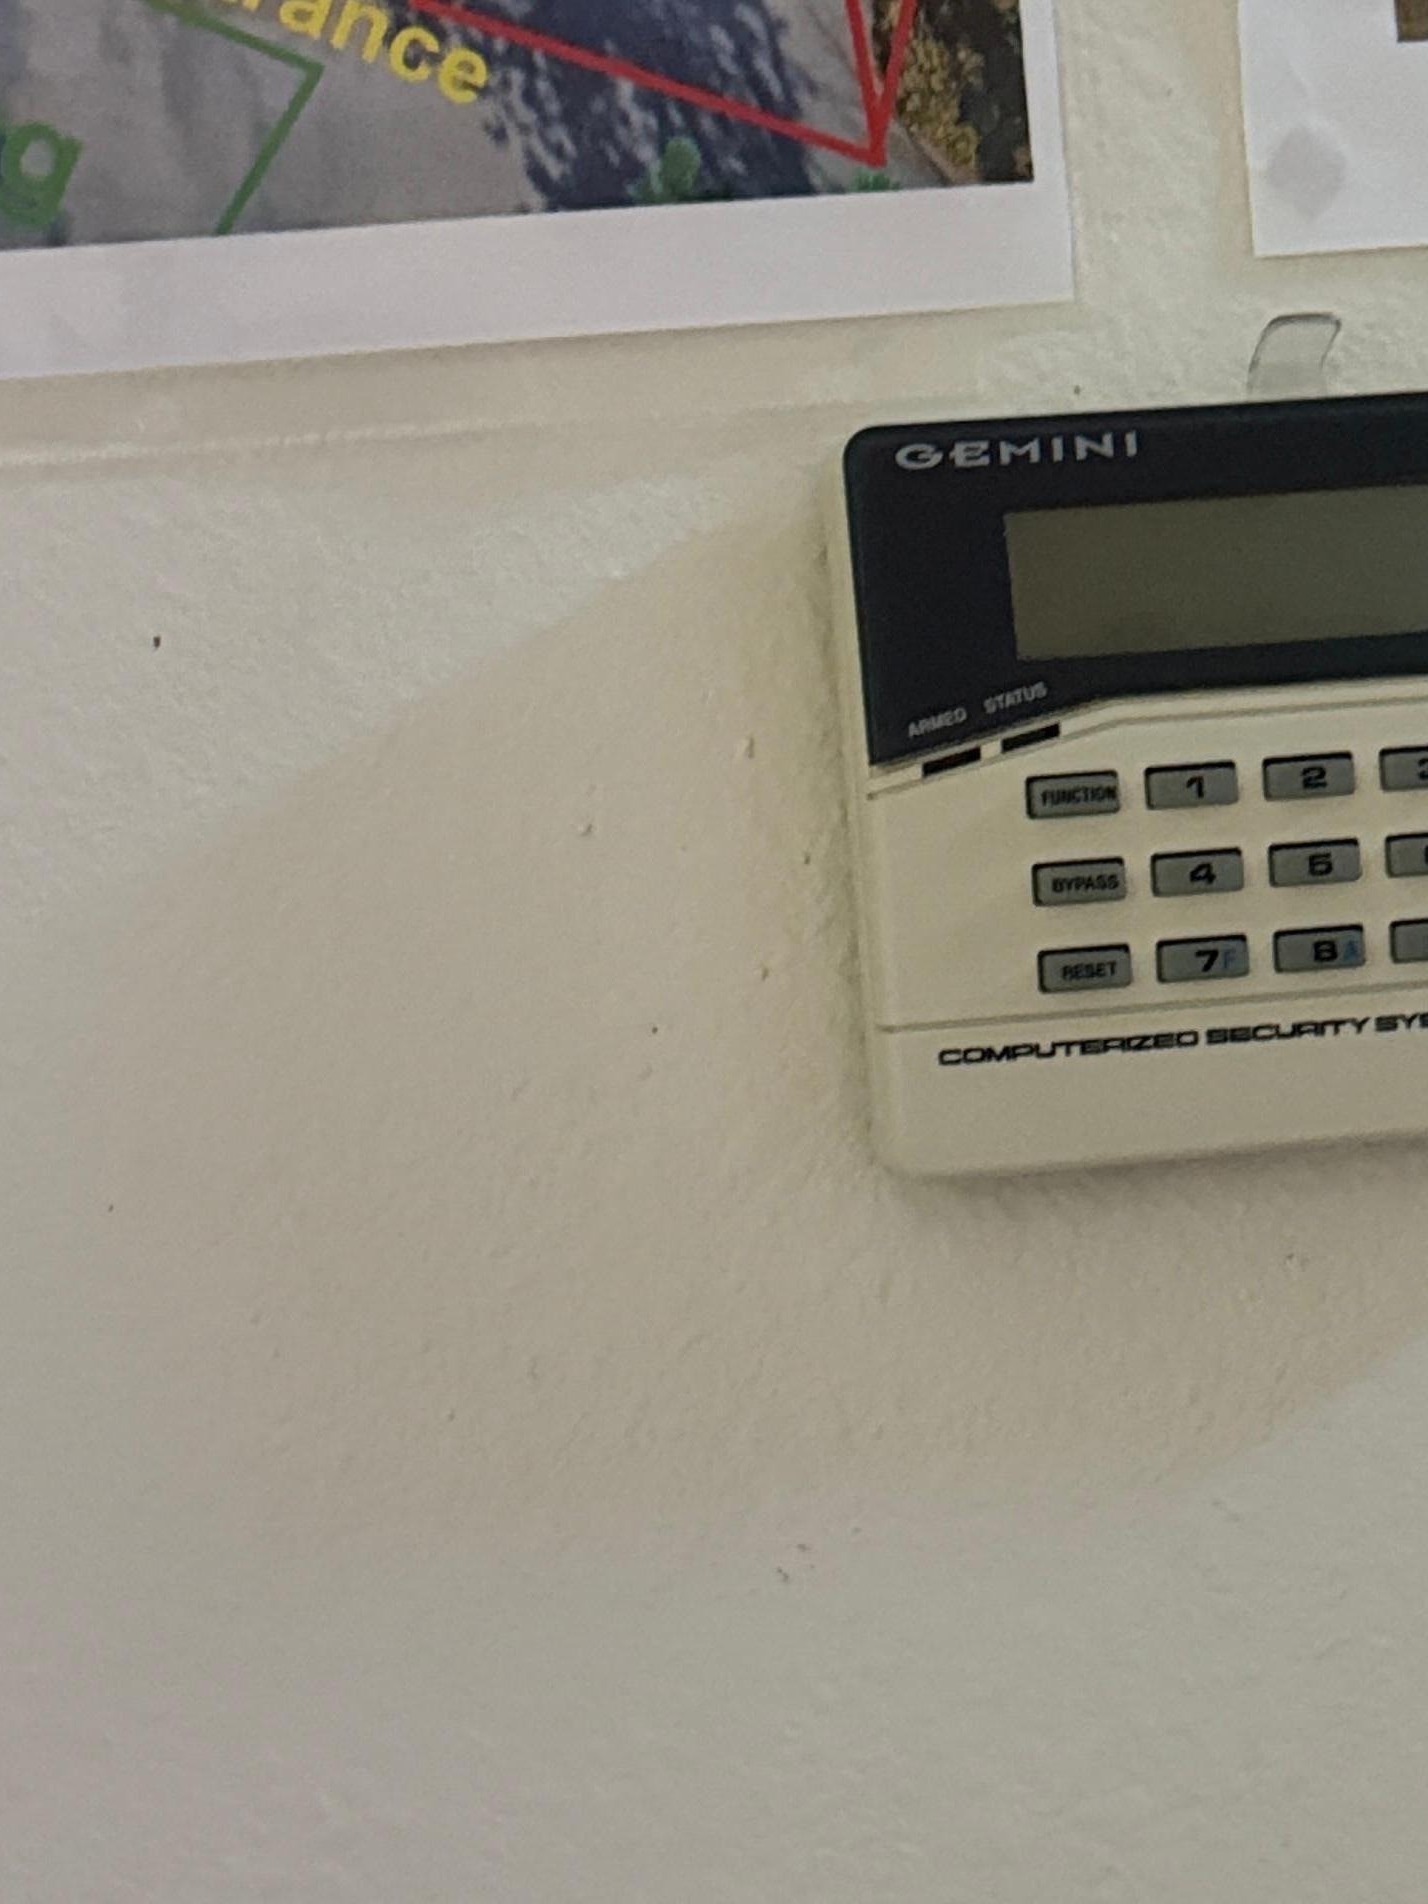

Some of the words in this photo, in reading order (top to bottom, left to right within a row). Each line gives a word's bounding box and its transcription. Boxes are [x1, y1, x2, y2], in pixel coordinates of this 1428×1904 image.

[894, 429, 1140, 472] GEMINI
[983, 680, 1049, 715] STATUS
[1186, 776, 1206, 799] 1
[1300, 767, 1329, 790] 2
[1040, 784, 1117, 807] FUNCTION
[1051, 874, 1120, 894] BYPASS
[1189, 863, 1216, 886] 4
[938, 1030, 1200, 1066] COMPUTERIZED
[1206, 1016, 1370, 1045] SECURITY
